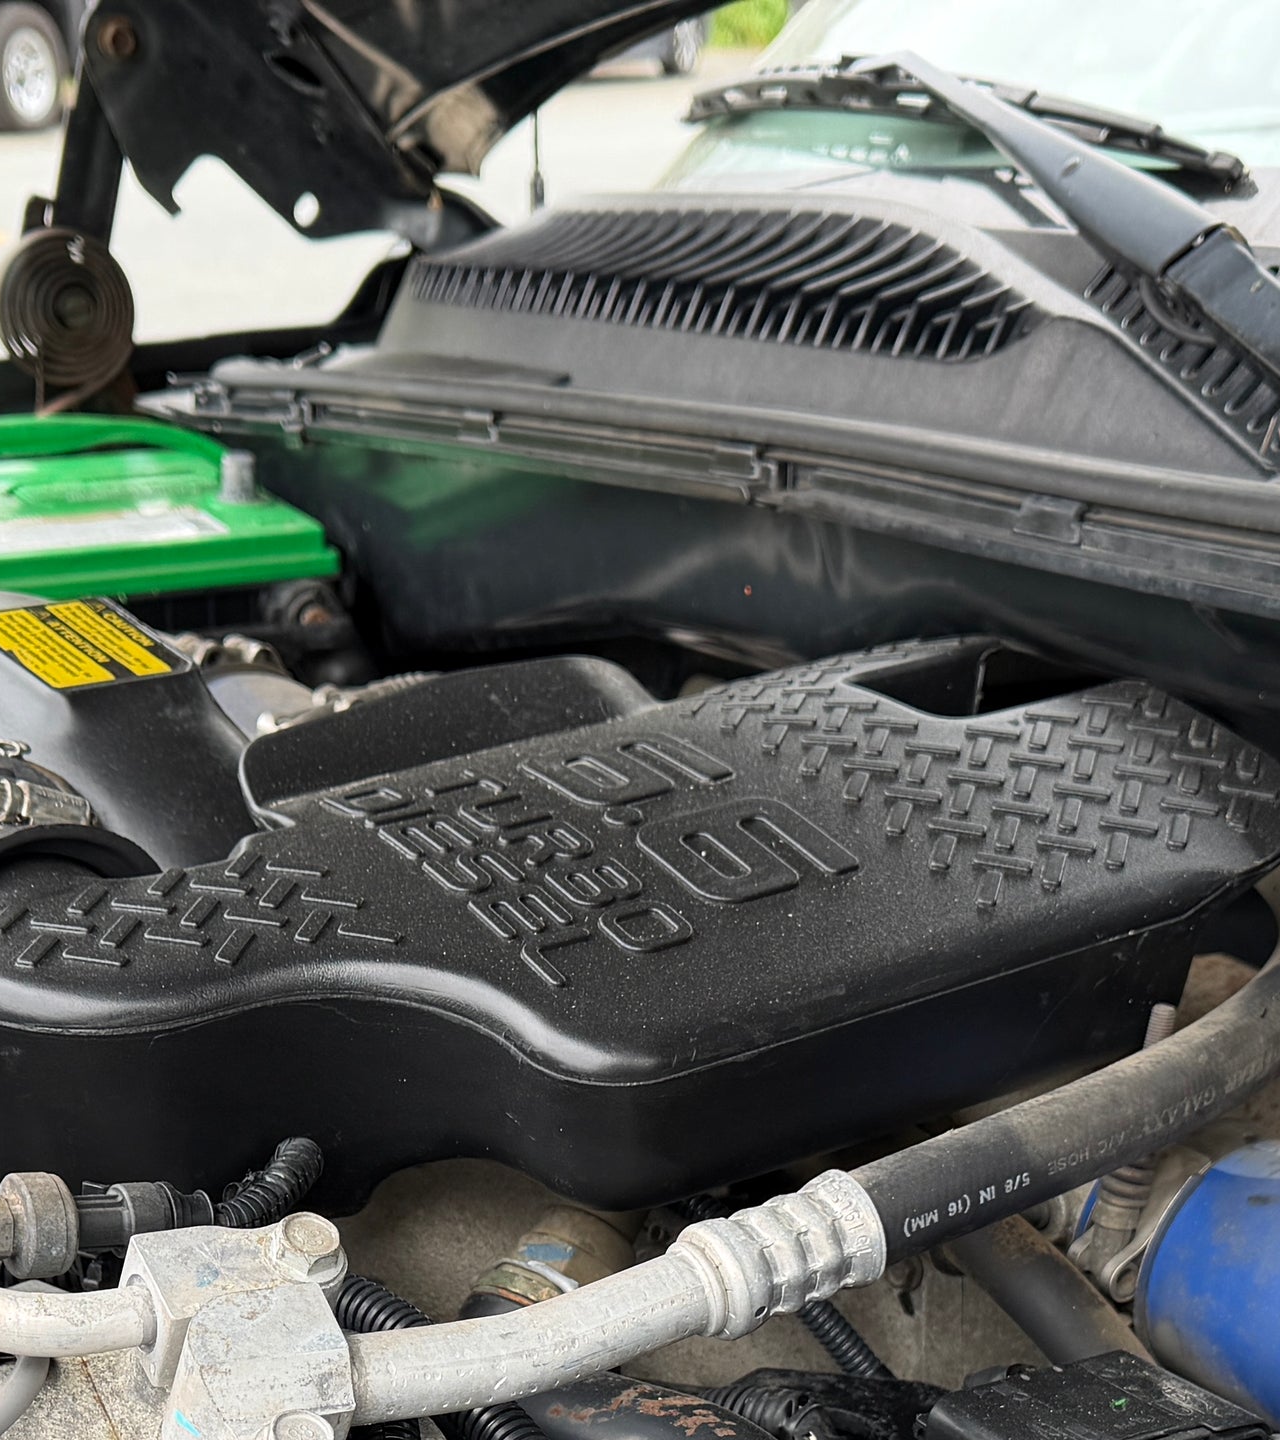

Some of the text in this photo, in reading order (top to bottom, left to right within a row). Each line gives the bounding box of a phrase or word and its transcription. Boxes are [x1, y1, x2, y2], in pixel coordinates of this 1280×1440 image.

[46, 619, 111, 664] ATTENTION
[102, 611, 155, 648] CAUTION
[520, 733, 860, 903] 6.6
[423, 768, 695, 953] TURBO
[319, 786, 591, 988] DIESEL
[1047, 1147, 1090, 1176] HOSE
[978, 1185, 996, 1205] IN
[1004, 1171, 1031, 1194] 5/8
[903, 1208, 940, 1238] MM)
[947, 1194, 971, 1219] (16
